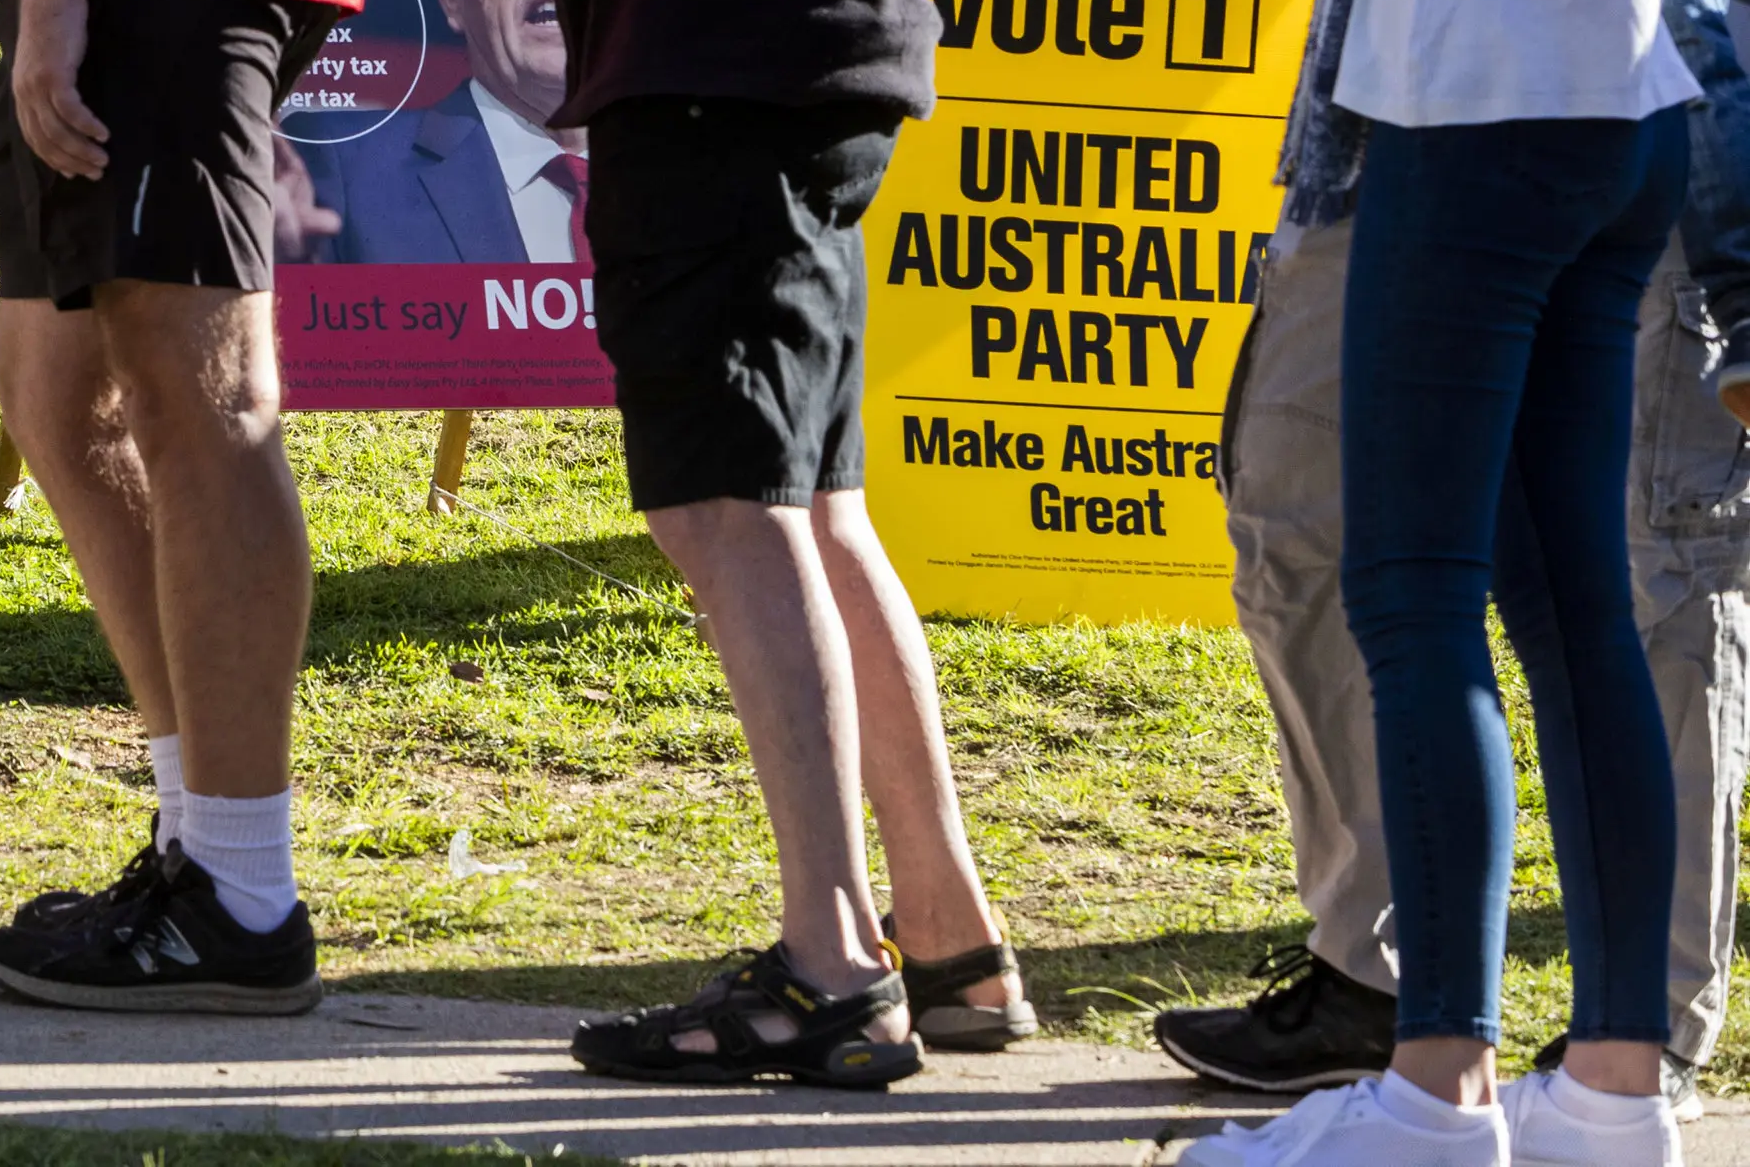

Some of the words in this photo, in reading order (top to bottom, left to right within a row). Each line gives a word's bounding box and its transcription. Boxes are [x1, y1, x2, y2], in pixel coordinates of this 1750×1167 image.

[349, 56, 388, 76] tax
[318, 89, 357, 108] tax
[959, 126, 1221, 214] UNITED
[302, 292, 388, 332] Just
[401, 300, 469, 340] say
[483, 277, 598, 331] NO!
[970, 304, 1210, 390] PARTY
[903, 415, 1045, 472] Make
[1030, 481, 1167, 537] Great
